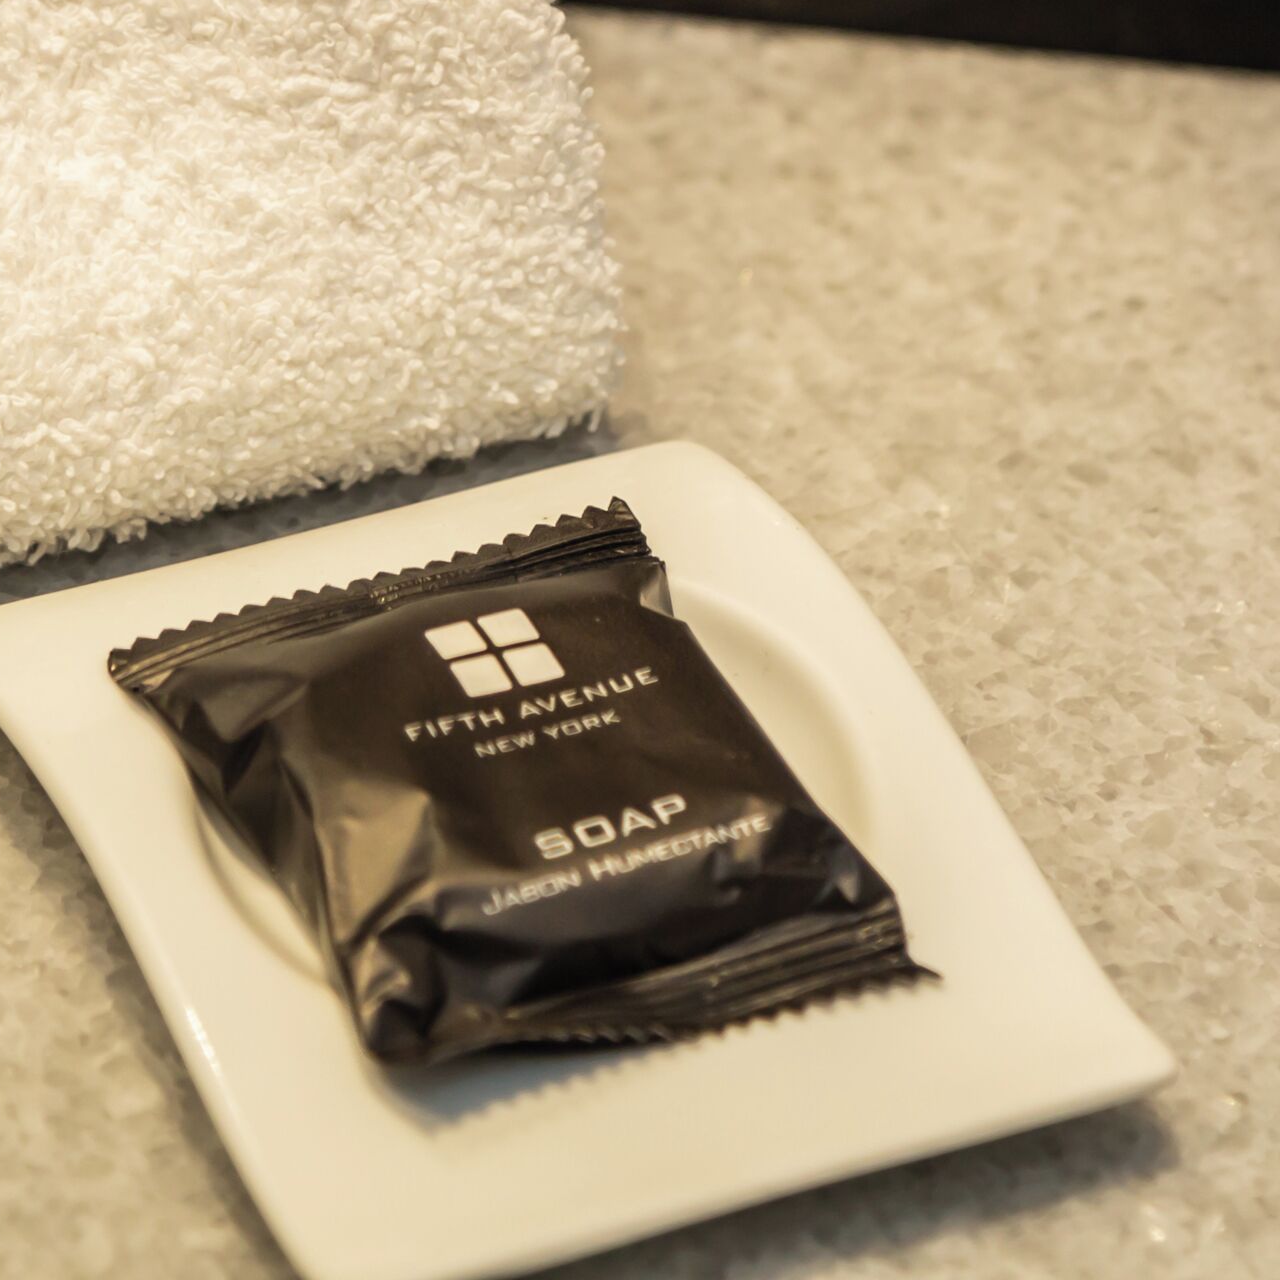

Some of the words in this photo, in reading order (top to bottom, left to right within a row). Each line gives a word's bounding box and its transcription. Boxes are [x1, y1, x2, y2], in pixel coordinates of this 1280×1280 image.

[403, 708, 505, 742] FIFTH
[520, 666, 659, 719] AVENUE
[474, 730, 536, 758] NEW
[542, 708, 621, 740] YORK
[534, 793, 686, 860] SOAP
